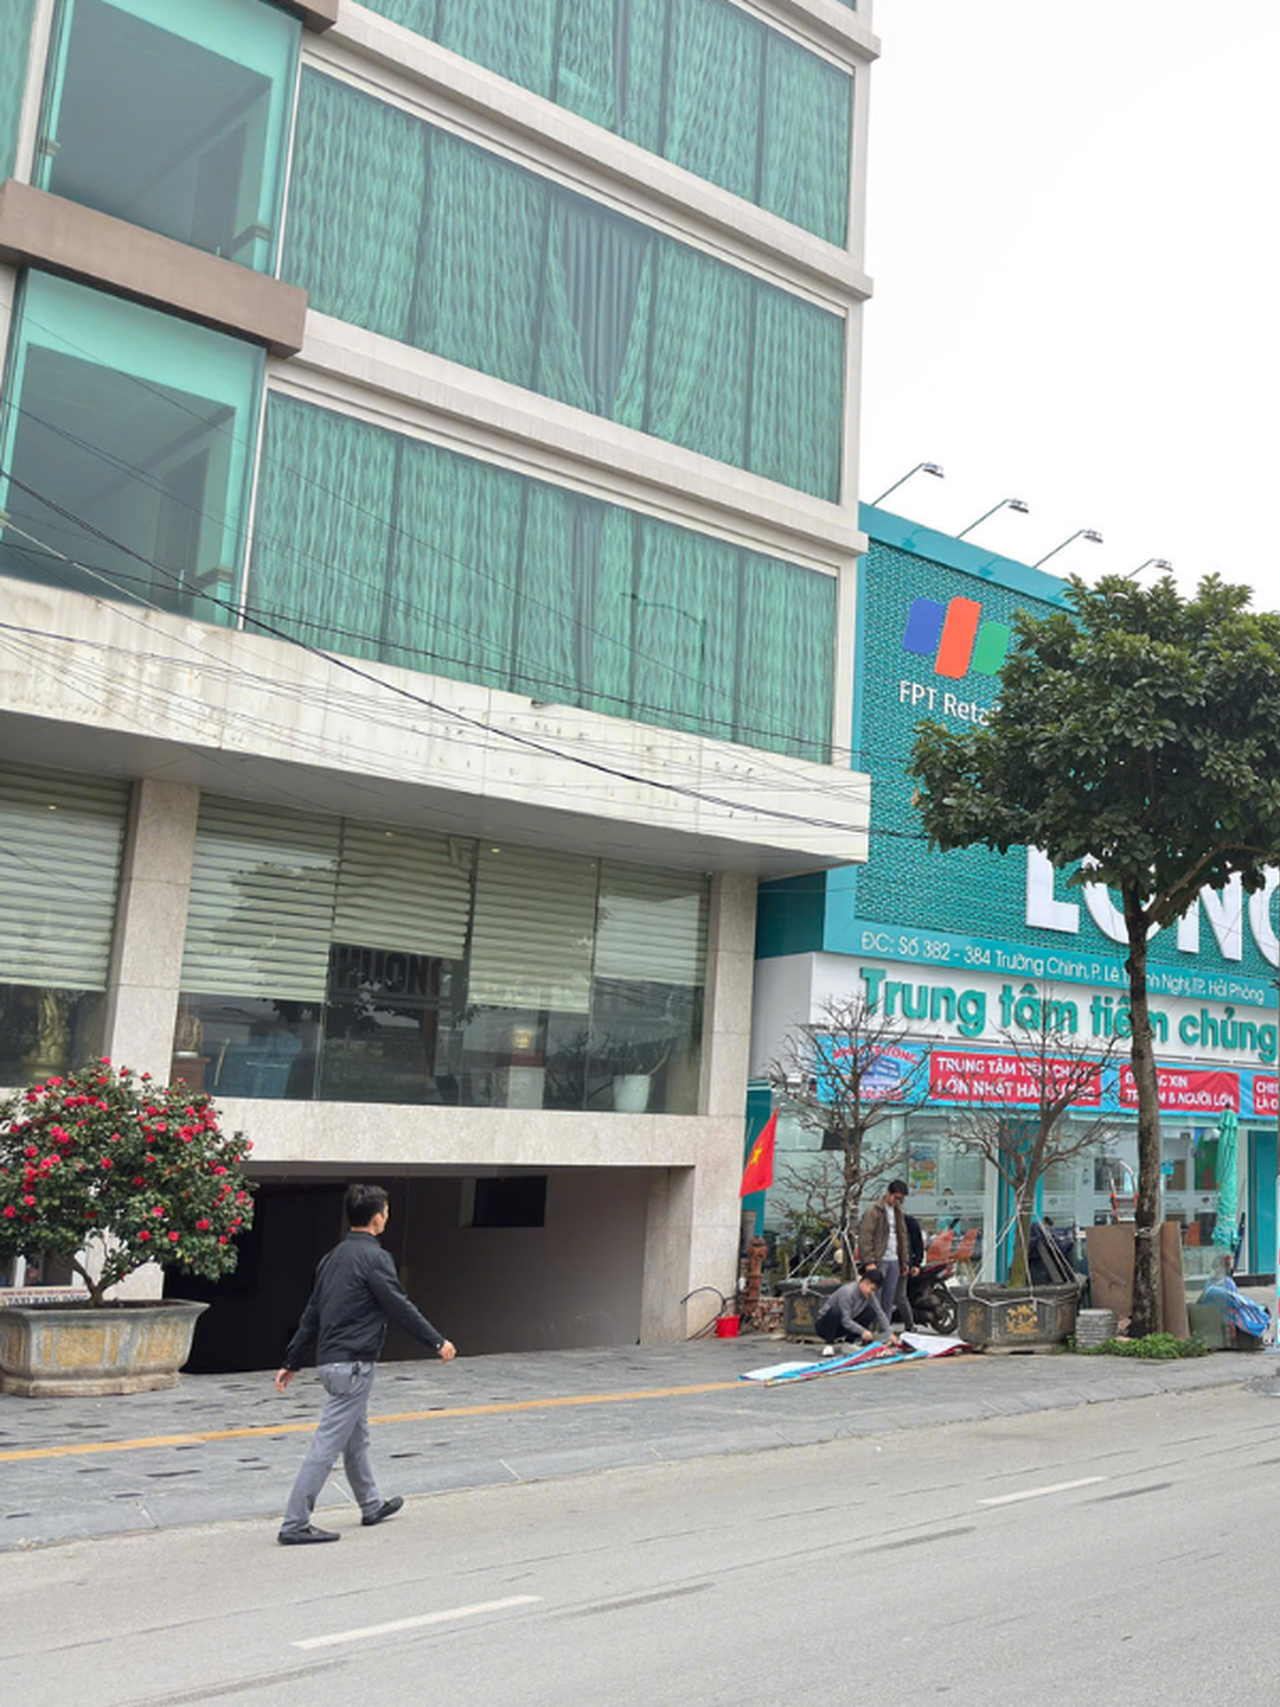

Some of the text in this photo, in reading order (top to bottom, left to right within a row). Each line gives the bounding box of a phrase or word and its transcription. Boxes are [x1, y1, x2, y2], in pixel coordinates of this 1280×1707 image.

[900, 680, 937, 711] FPT
[861, 931, 894, 952] ĐC:
[899, 936, 919, 955] Số
[923, 940, 950, 961] 382
[964, 945, 991, 965] 384
[995, 951, 1044, 976] Trường
[1104, 966, 1120, 982] Lê
[1208, 980, 1228, 999] Hải
[1229, 987, 1265, 1004] Phòng
[860, 967, 986, 1038] Trung
[1000, 983, 1078, 1034] tâm
[1179, 1006, 1278, 1063] chủng
[936, 1057, 985, 1074] TRUNG
[988, 1058, 1016, 1076] TÂM
[973, 1077, 1014, 1098] NHẤT
[1169, 1076, 1188, 1088] XIN
